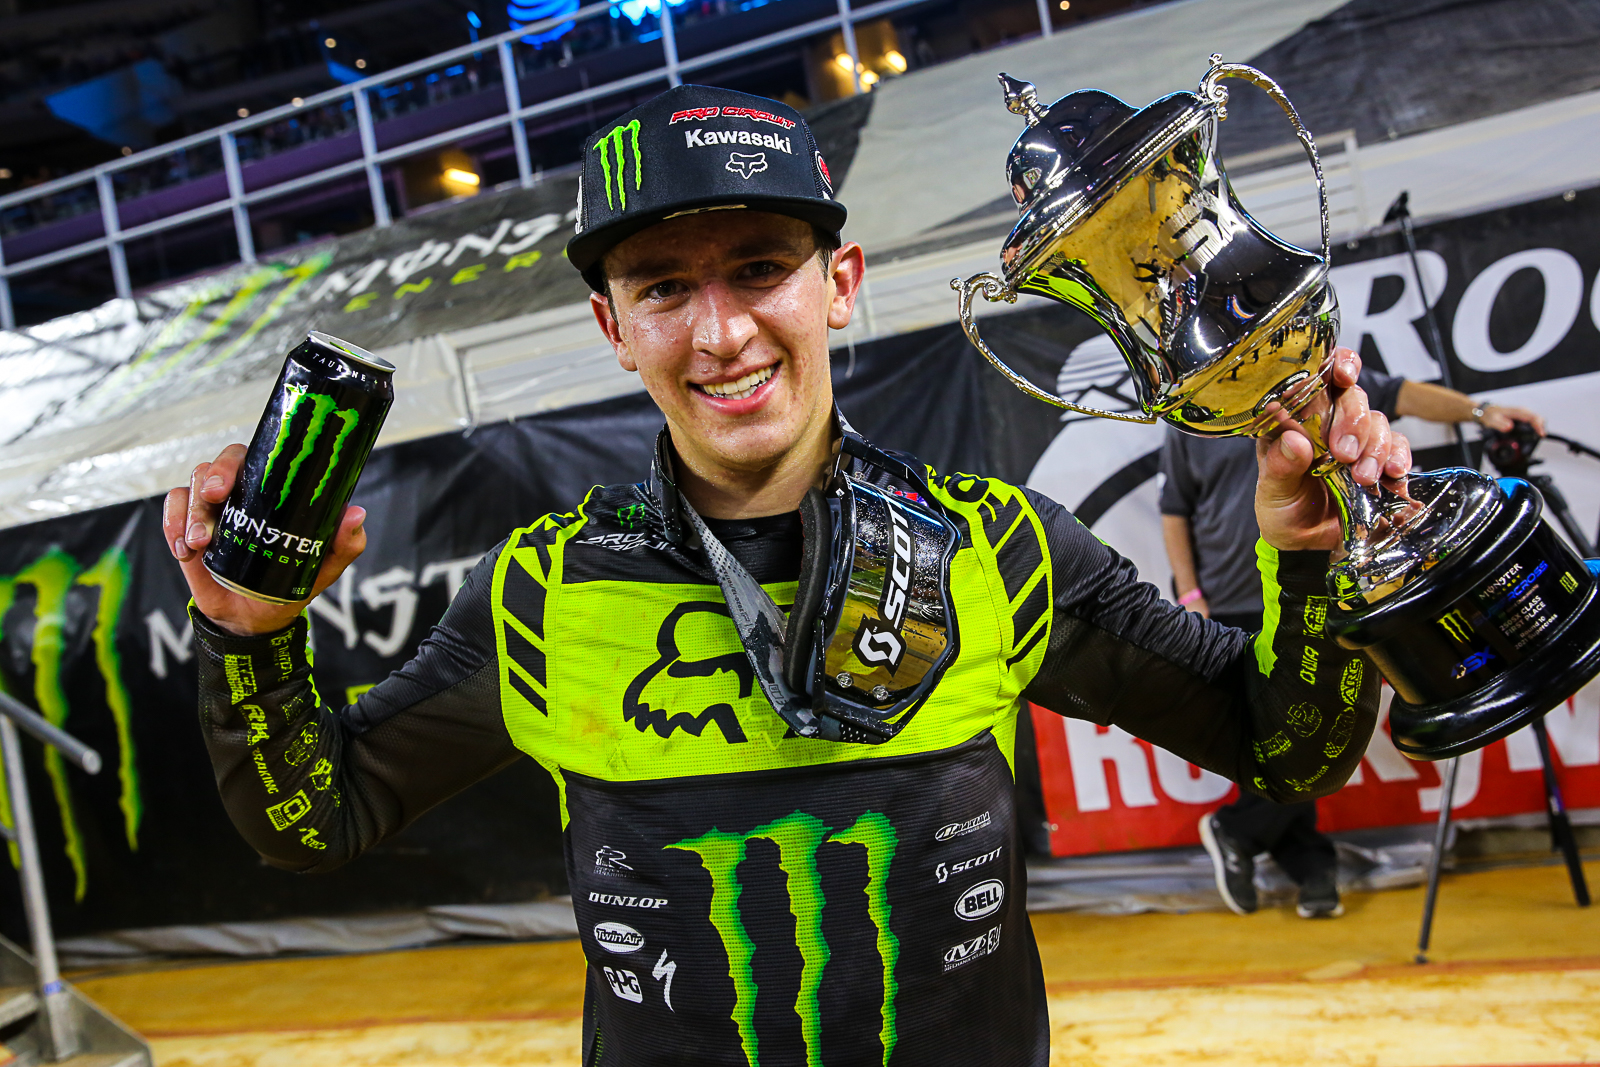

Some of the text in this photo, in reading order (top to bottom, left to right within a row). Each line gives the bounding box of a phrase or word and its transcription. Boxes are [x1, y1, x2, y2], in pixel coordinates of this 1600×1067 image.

[669, 106, 797, 130] PRO CIRCUIT
[684, 128, 793, 155] Kawasaki
[309, 208, 577, 304] MONS
[343, 250, 568, 313] ENER
[1329, 247, 1600, 382] RO
[312, 353, 366, 382] TAURNE
[223, 529, 303, 567] ENERGY
[1504, 601, 1546, 637] FIRST PLACE
[1520, 595, 1542, 615] CLASS
[1520, 615, 1547, 639] Round 10
[1528, 613, 1558, 640] Supercross
[950, 846, 1003, 875] SCOTT
[588, 892, 669, 909] DUNLOP
[964, 886, 1000, 914] BELL
[596, 928, 643, 946] Twin Air
